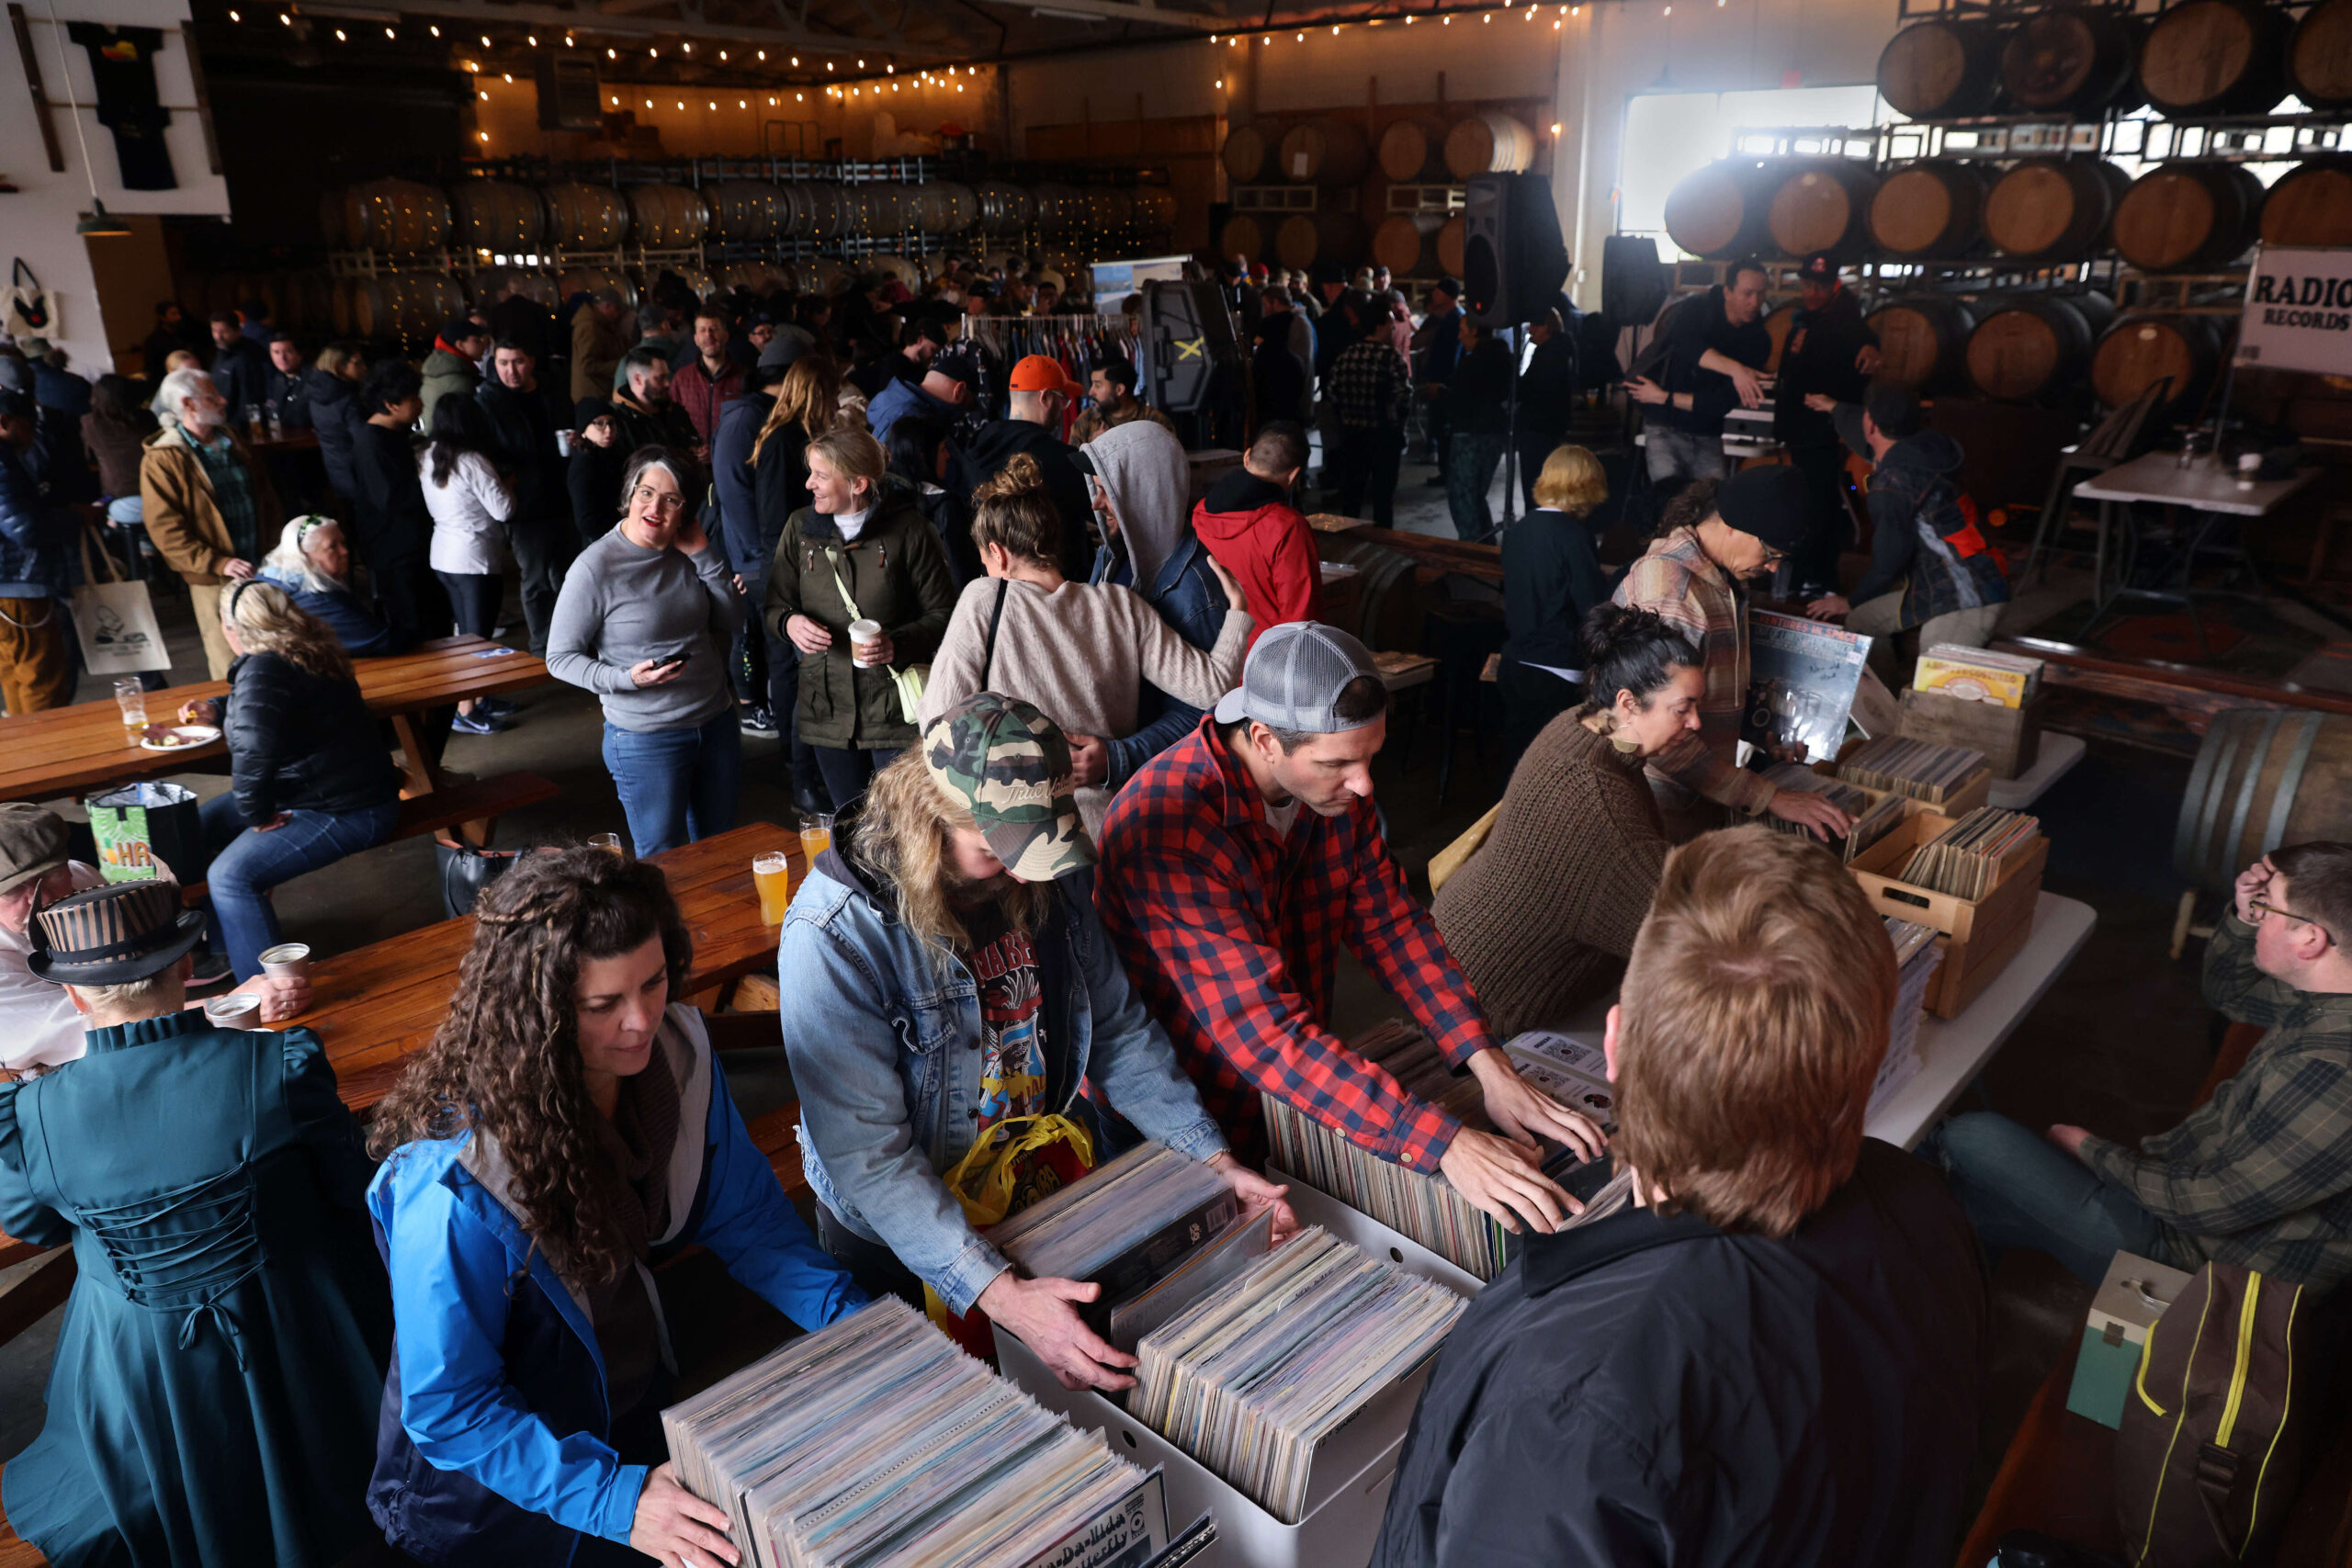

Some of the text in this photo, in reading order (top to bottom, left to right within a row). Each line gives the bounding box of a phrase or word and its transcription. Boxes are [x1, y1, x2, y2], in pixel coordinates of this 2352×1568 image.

[2254, 276, 2352, 308] RADIO
[2263, 308, 2351, 331] RECORDS
[1826, 628, 1857, 643] SPACE
[1001, 784, 1042, 805] True
